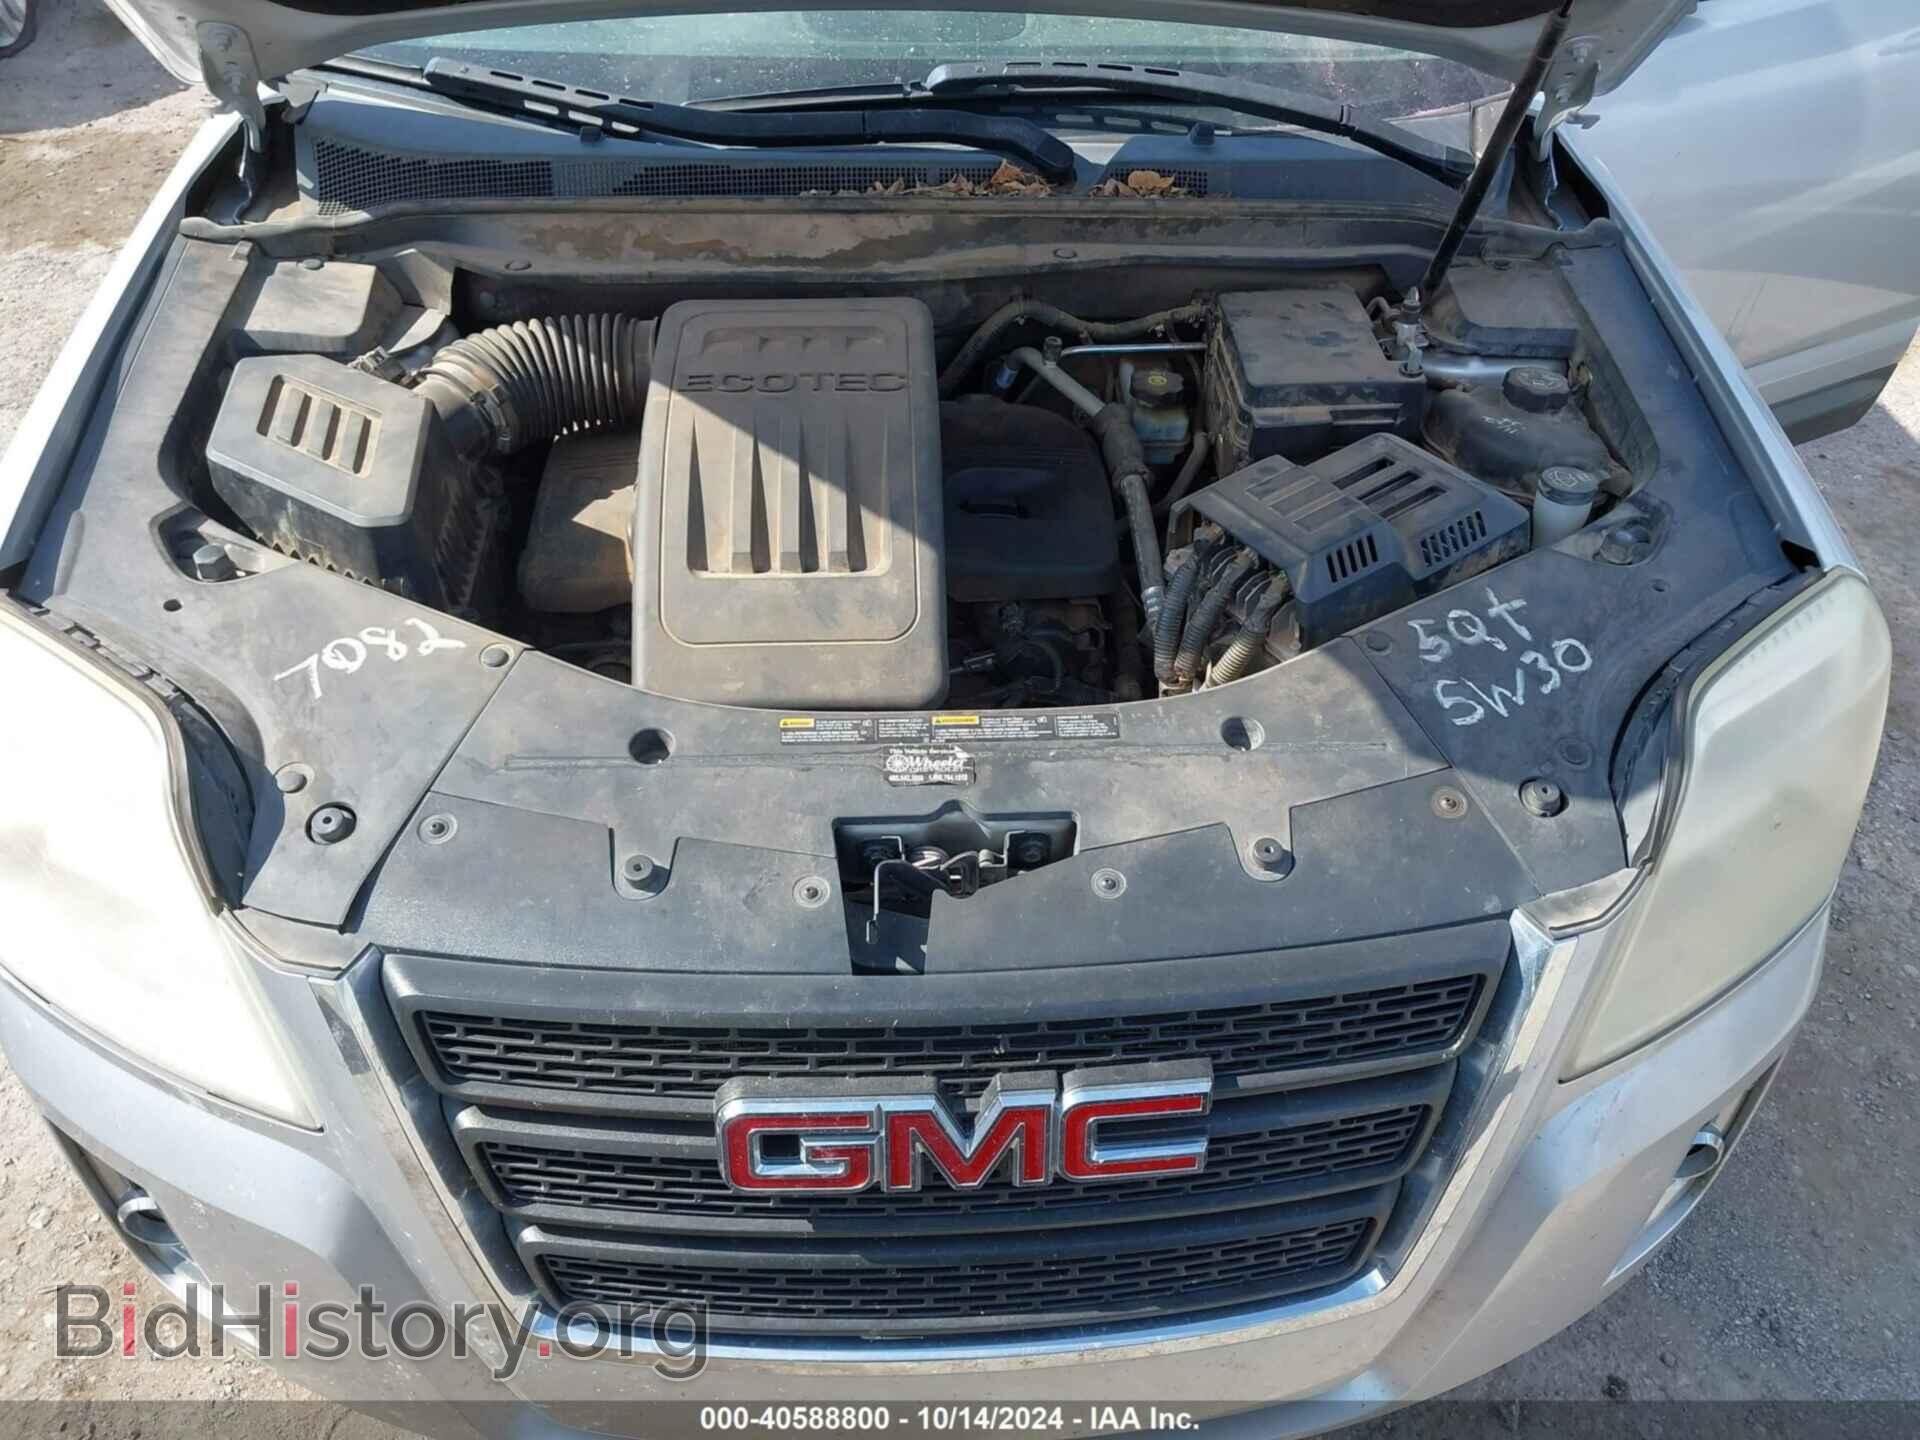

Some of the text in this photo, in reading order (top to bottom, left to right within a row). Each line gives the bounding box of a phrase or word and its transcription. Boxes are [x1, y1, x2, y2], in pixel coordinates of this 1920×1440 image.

[679, 372, 908, 393] ECOTEC
[273, 617, 467, 699] 7082
[1433, 637, 1593, 726] 5W30
[715, 1074, 1213, 1192] GMC
